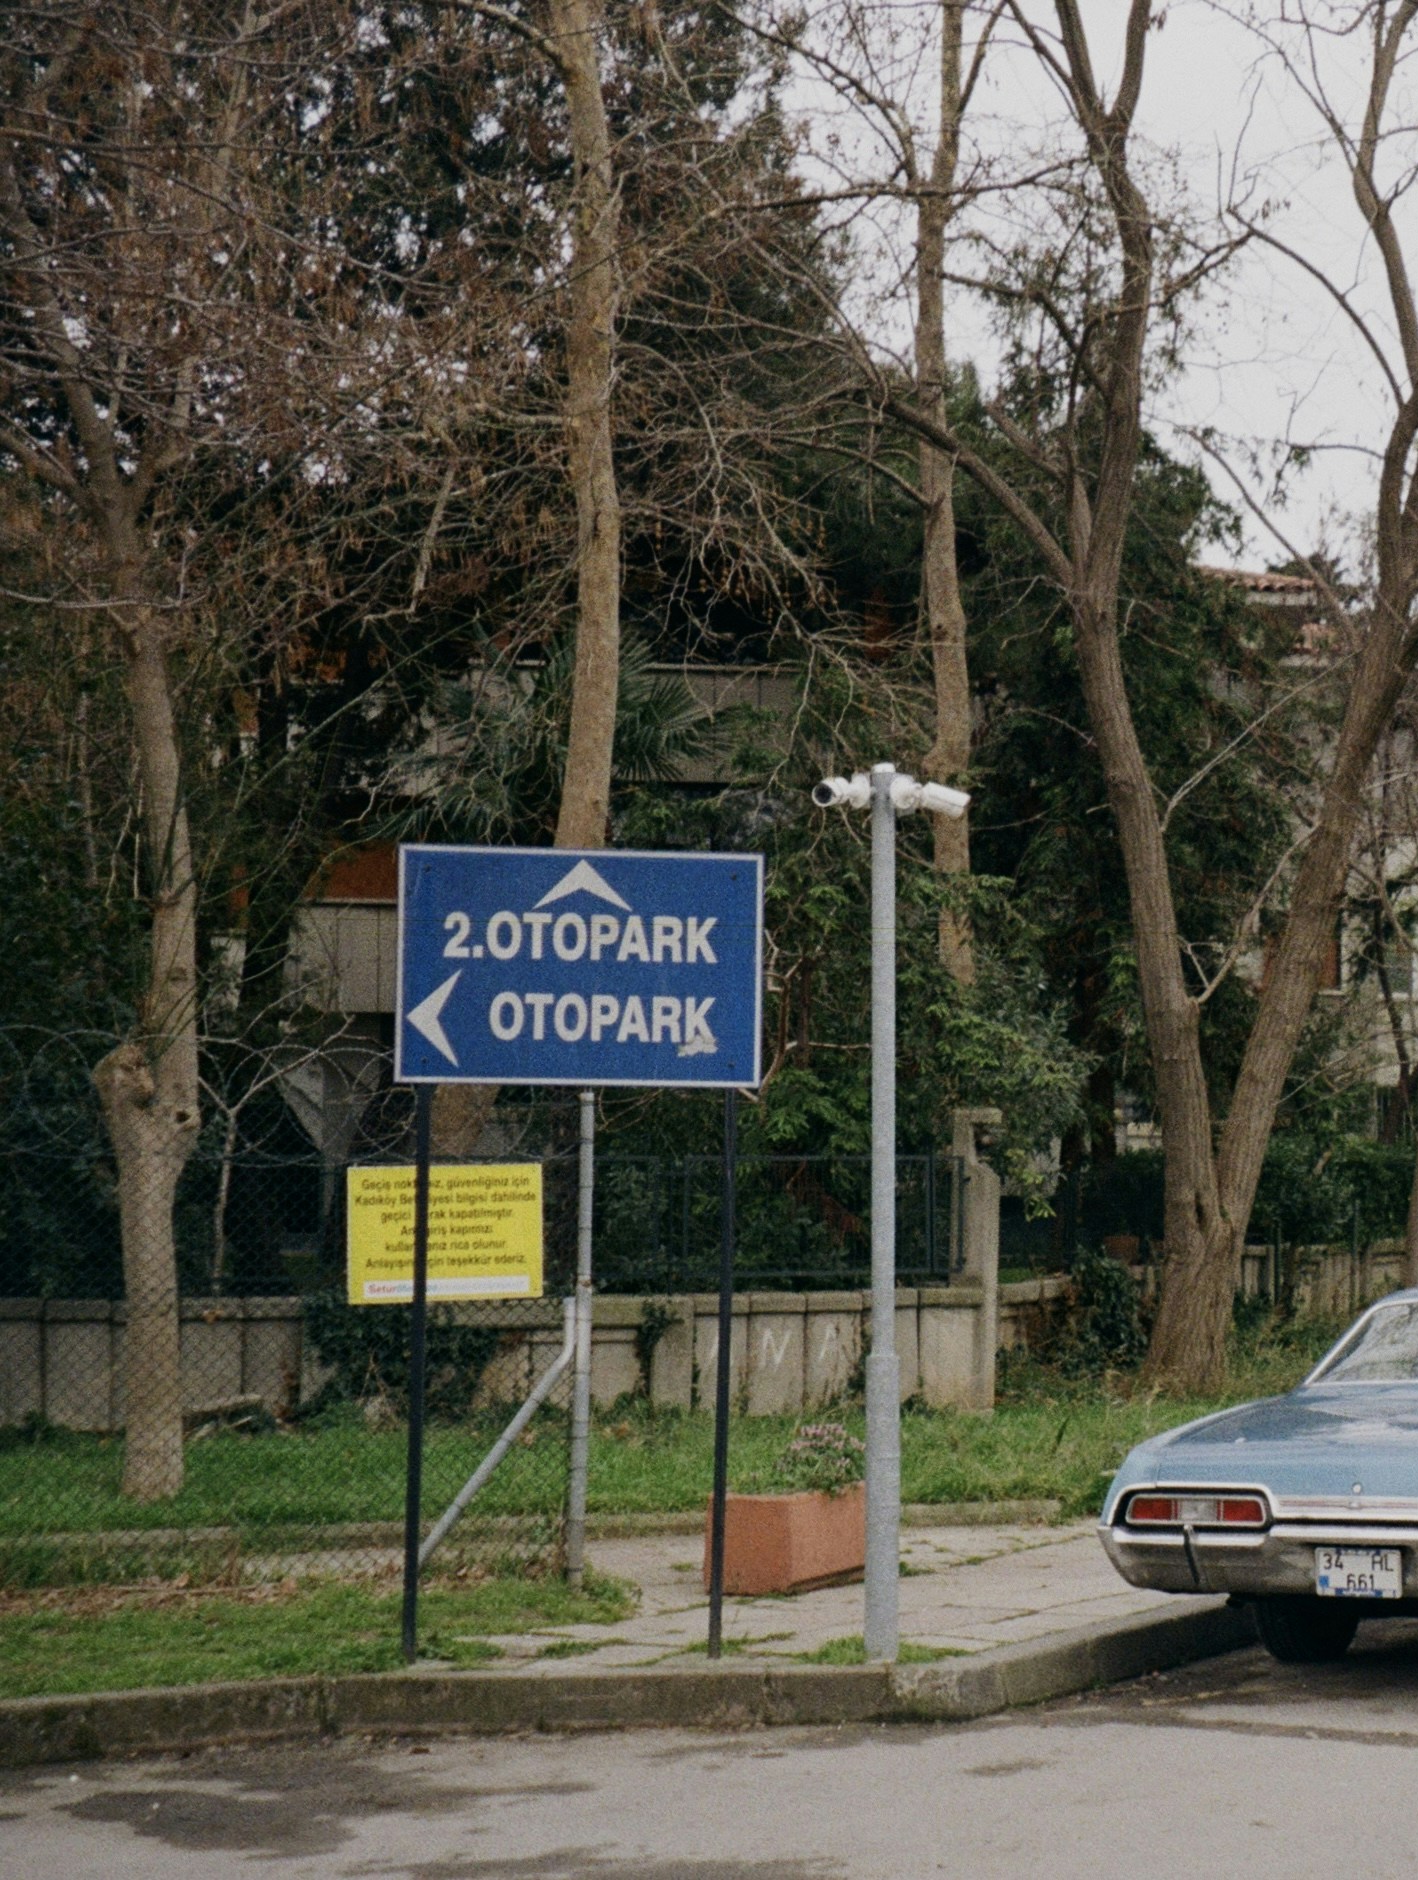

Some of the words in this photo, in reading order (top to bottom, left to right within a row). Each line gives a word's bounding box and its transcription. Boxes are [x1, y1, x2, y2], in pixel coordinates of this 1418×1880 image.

[443, 910, 718, 964] 2.OTOPARK
[489, 991, 717, 1044] OTOPARK
[1323, 1552, 1344, 1571] 34
[1371, 1553, 1394, 1572] HL
[1347, 1573, 1375, 1592] 661
